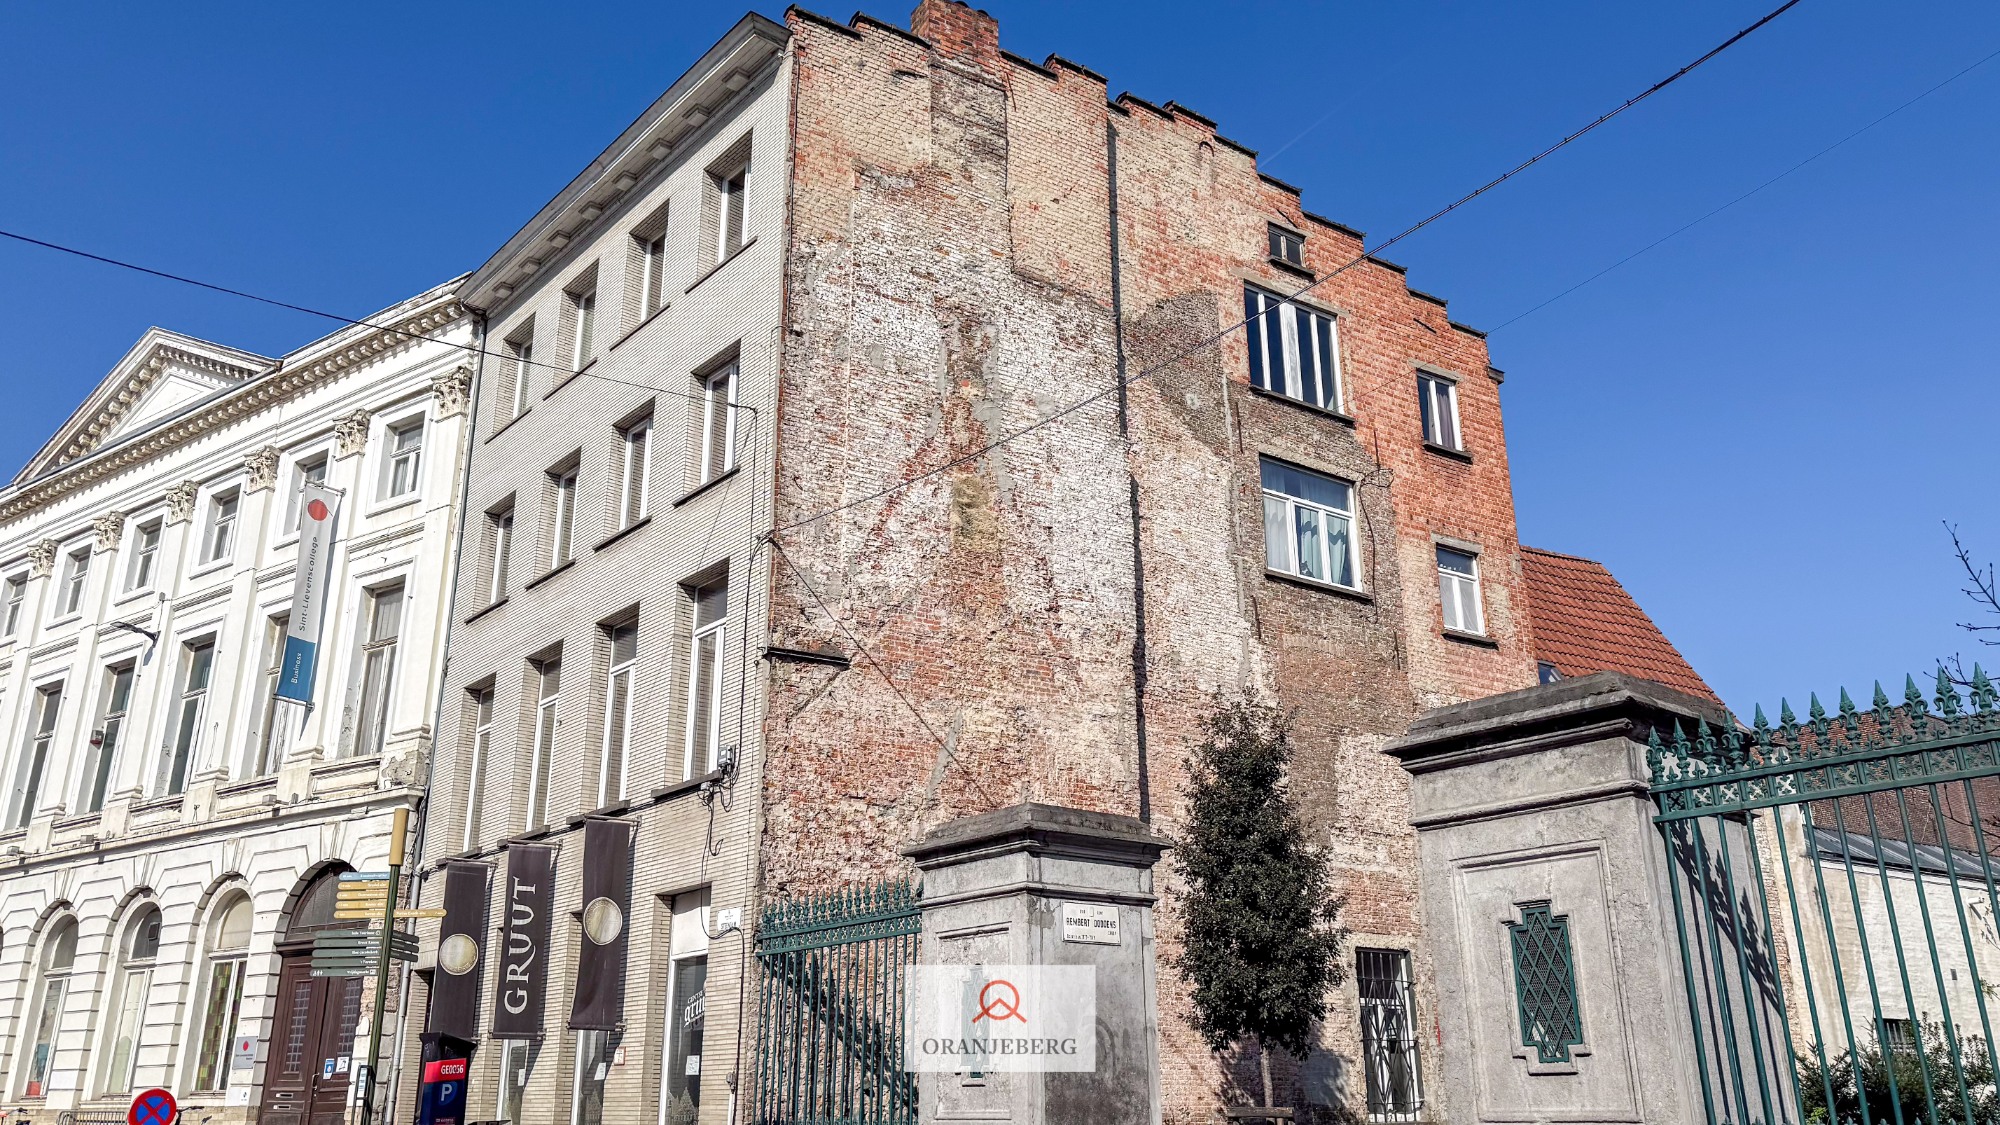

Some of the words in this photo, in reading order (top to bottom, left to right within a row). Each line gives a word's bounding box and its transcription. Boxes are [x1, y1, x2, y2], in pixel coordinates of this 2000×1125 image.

[298, 536, 318, 632] Sint-Lievenscollege
[291, 652, 302, 684] Business
[504, 876, 536, 1015] GRUUT
[440, 1083, 453, 1102] P
